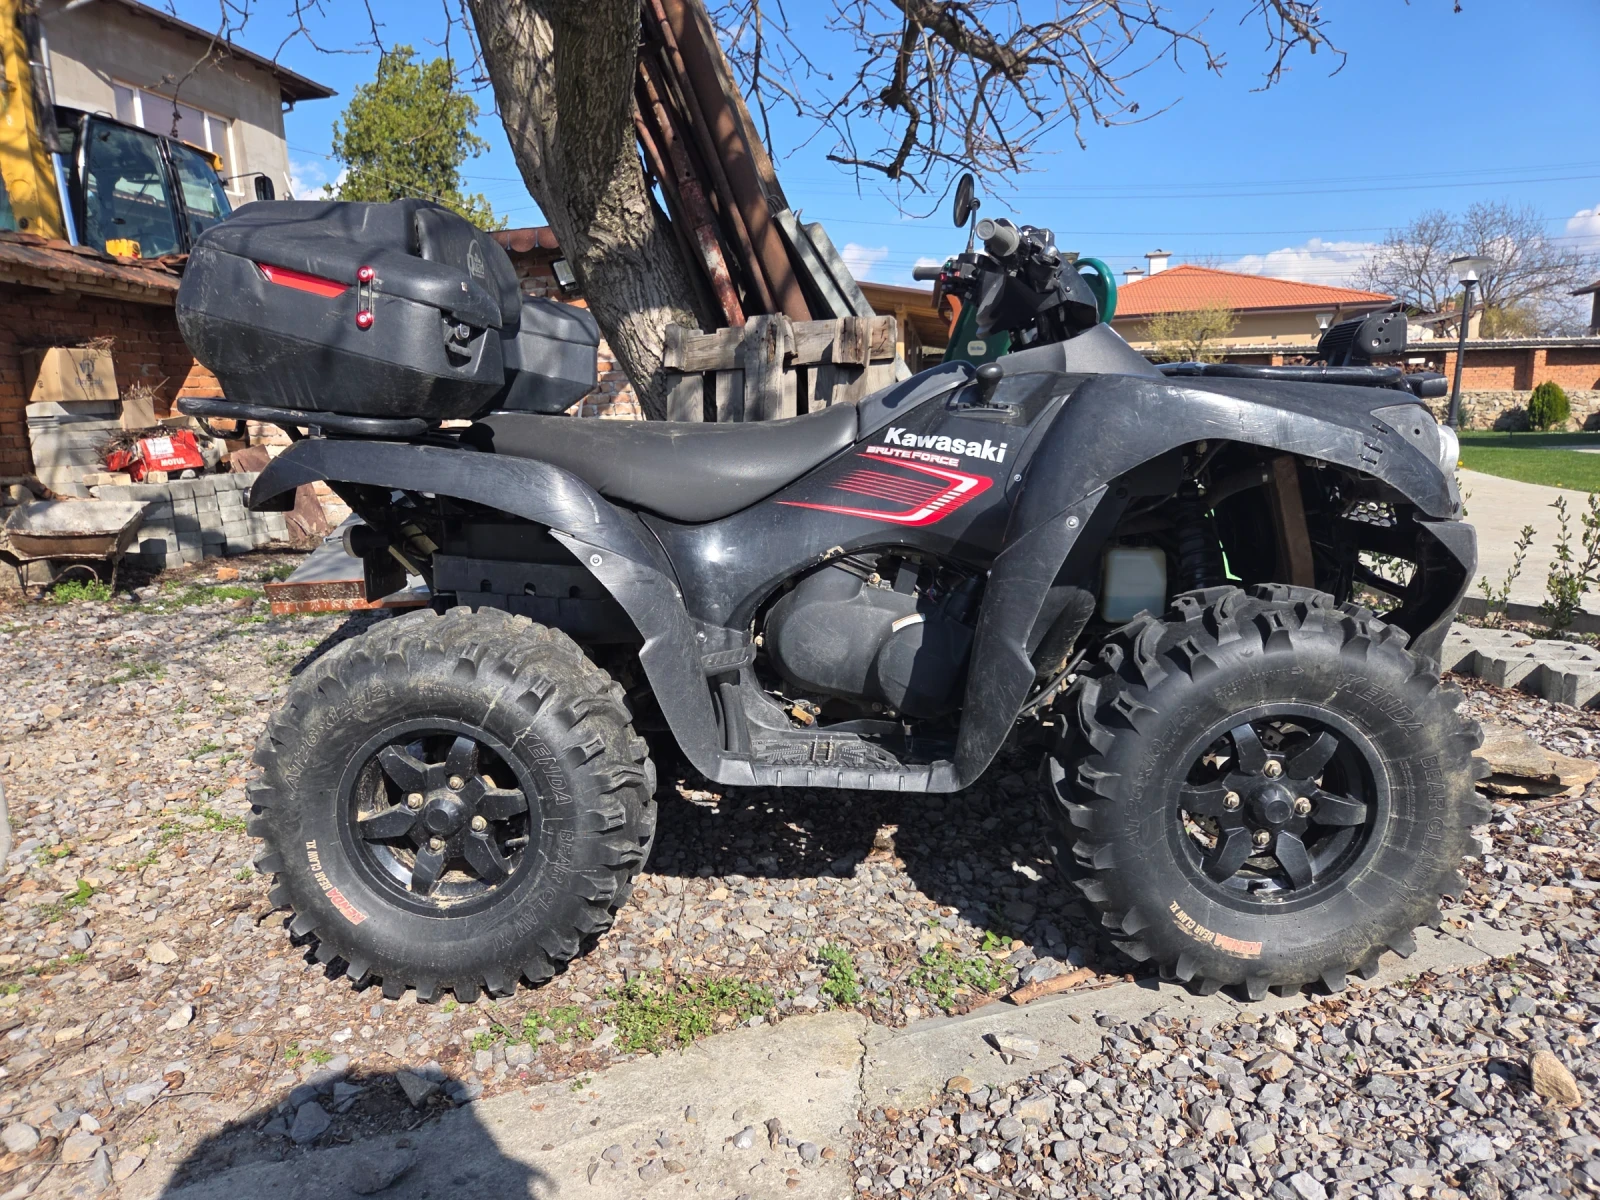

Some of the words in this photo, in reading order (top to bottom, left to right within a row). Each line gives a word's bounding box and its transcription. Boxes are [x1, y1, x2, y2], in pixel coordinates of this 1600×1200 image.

[866, 445, 911, 459] BRUTE
[911, 451, 960, 467] FORCE
[883, 427, 1008, 463] Kawasaki
[160, 457, 186, 467] MOTUL
[1336, 673, 1425, 738] KENDA
[512, 726, 573, 805] KENDA
[1420, 754, 1446, 811] BEAR
[305, 839, 317, 850] XL
[551, 828, 575, 884] BEAR
[1411, 816, 1445, 879] CLAW
[307, 851, 322, 872] CLAW
[314, 870, 334, 891] BEAR
[1396, 879, 1419, 903] XL
[325, 886, 368, 926] KENDA
[514, 886, 557, 938] CLAW
[1169, 900, 1181, 914] XL
[1175, 909, 1197, 930] CLAW
[1193, 923, 1215, 942] BEAR
